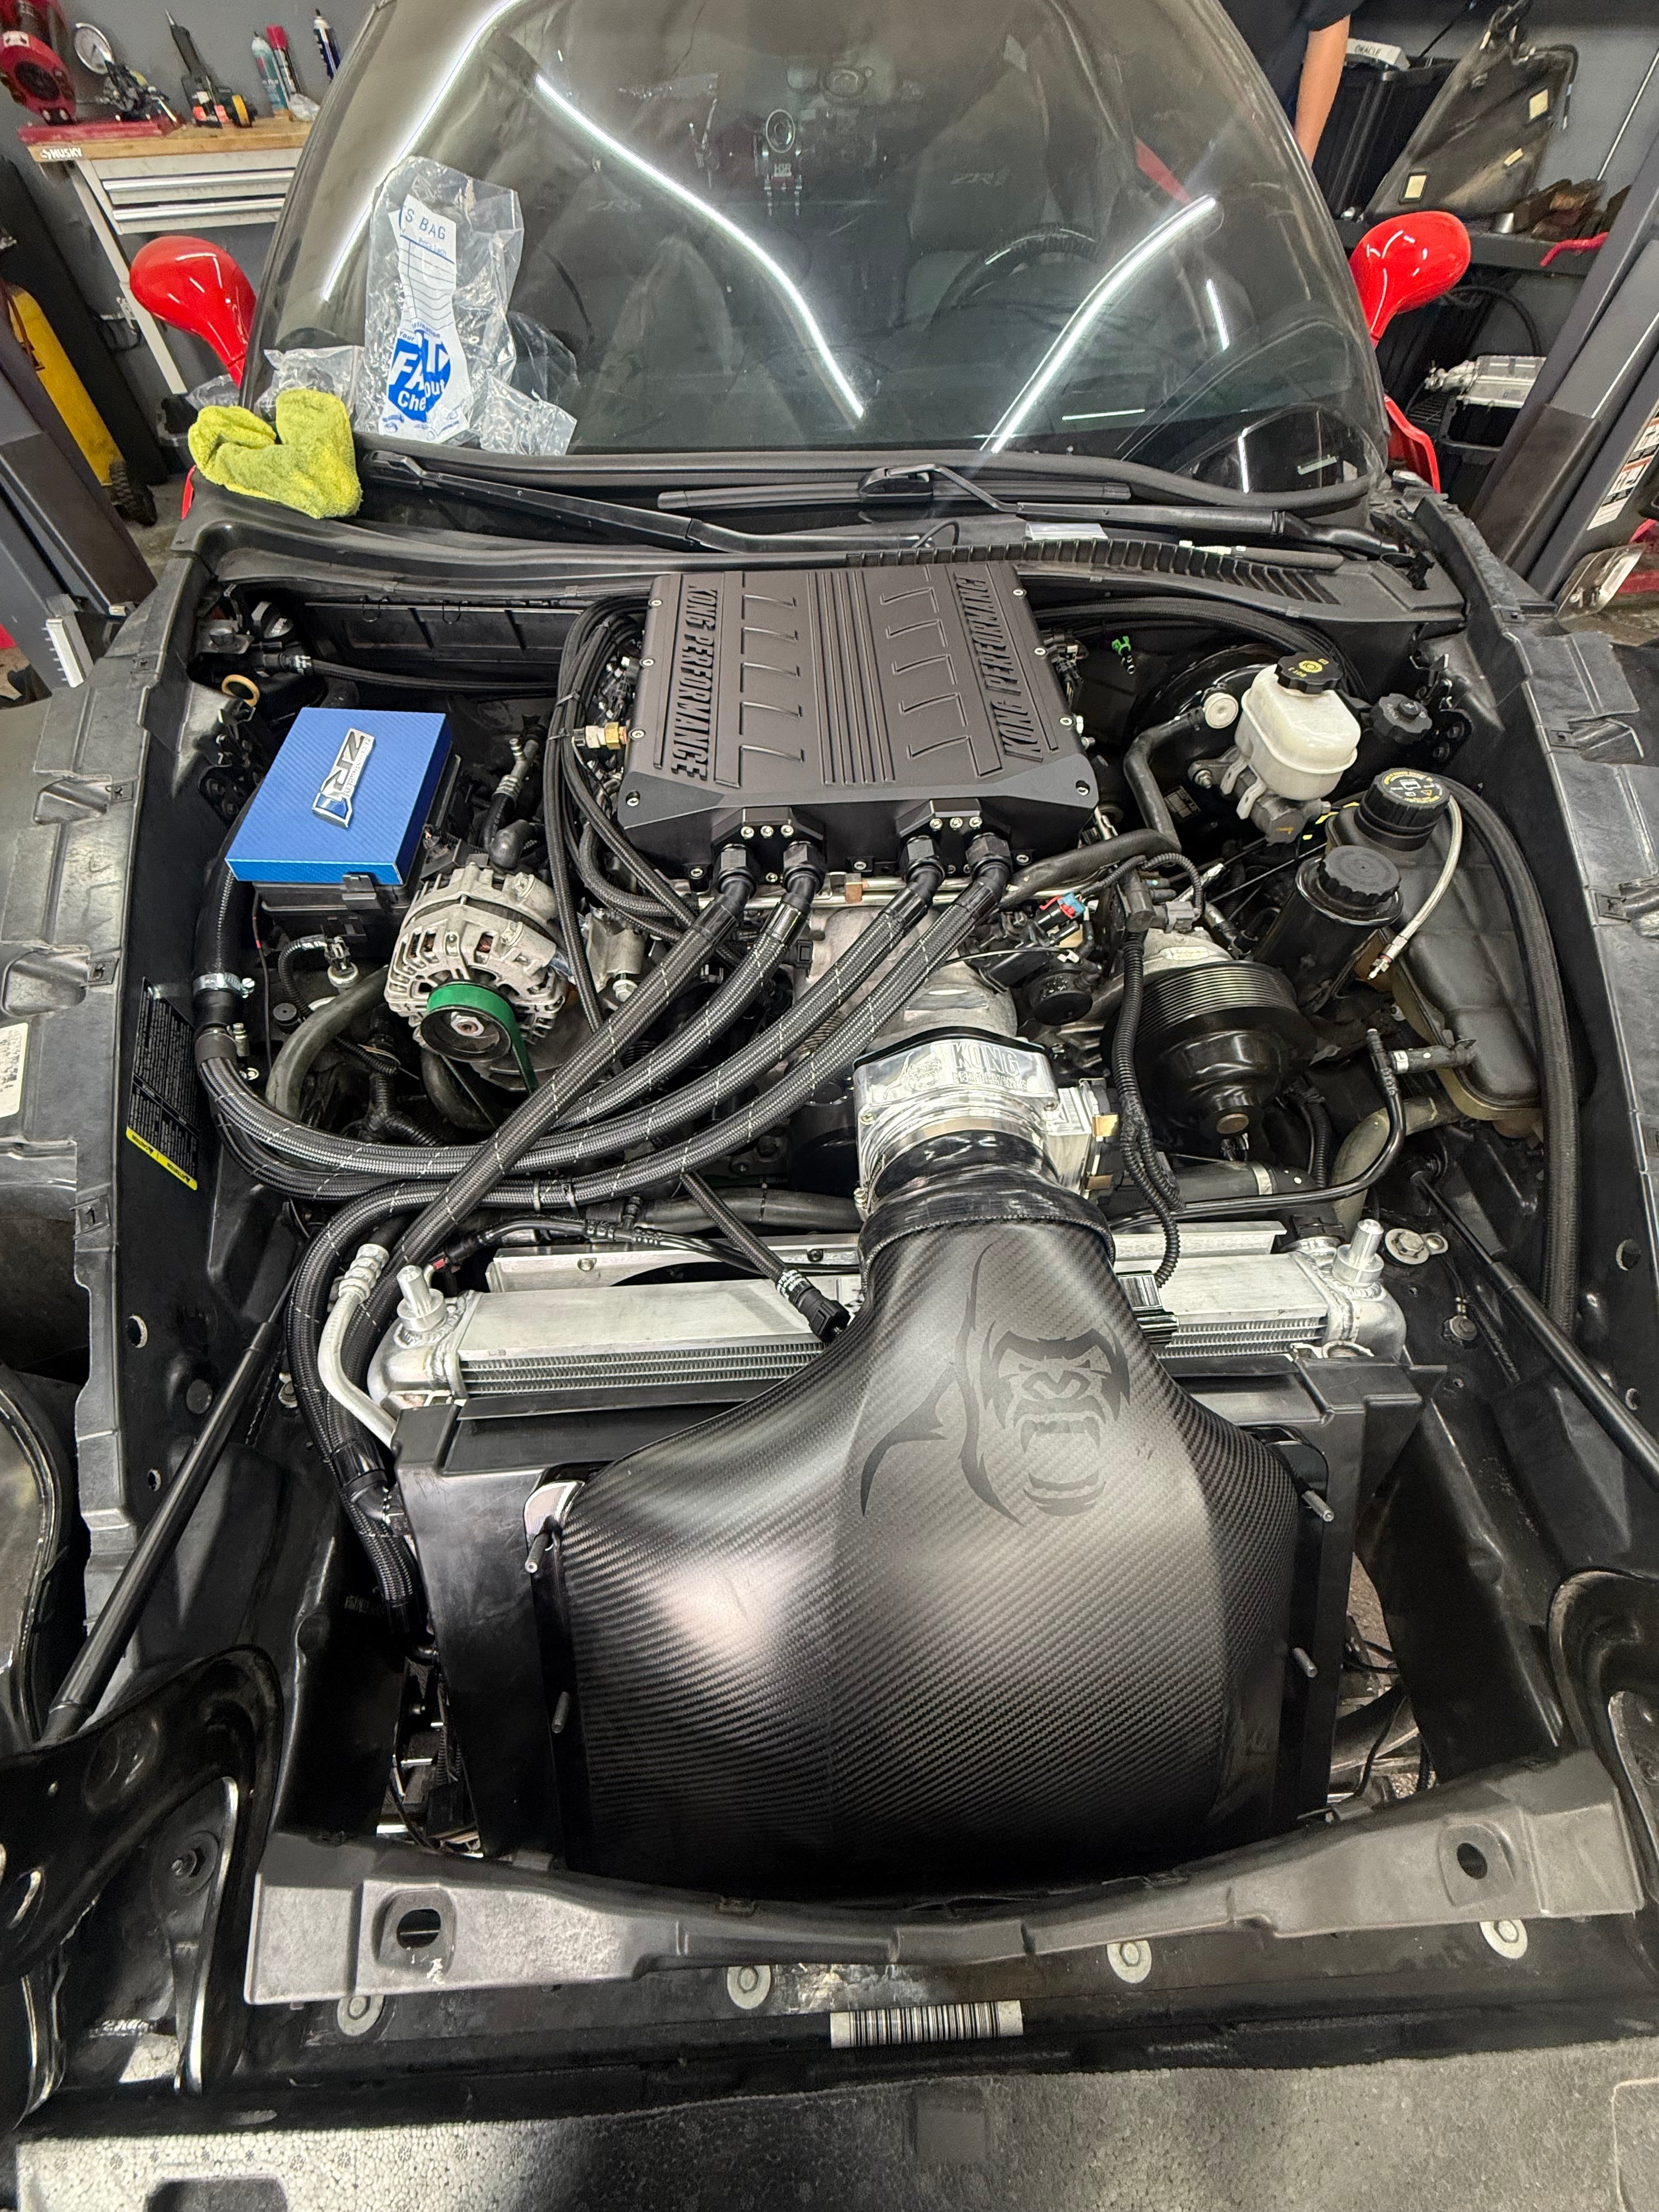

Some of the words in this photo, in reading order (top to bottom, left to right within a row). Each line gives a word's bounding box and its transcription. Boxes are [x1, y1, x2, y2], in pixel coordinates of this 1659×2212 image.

[49, 147, 82, 159] HUSKY
[419, 216, 446, 240] BAG
[399, 330, 415, 342] Your
[686, 585, 718, 631] KONG
[955, 573, 1022, 696] PERFORMANCE
[670, 631, 715, 781] PERFORMANCE
[990, 699, 1043, 763] KONG
[951, 1042, 1020, 1077] KONG
